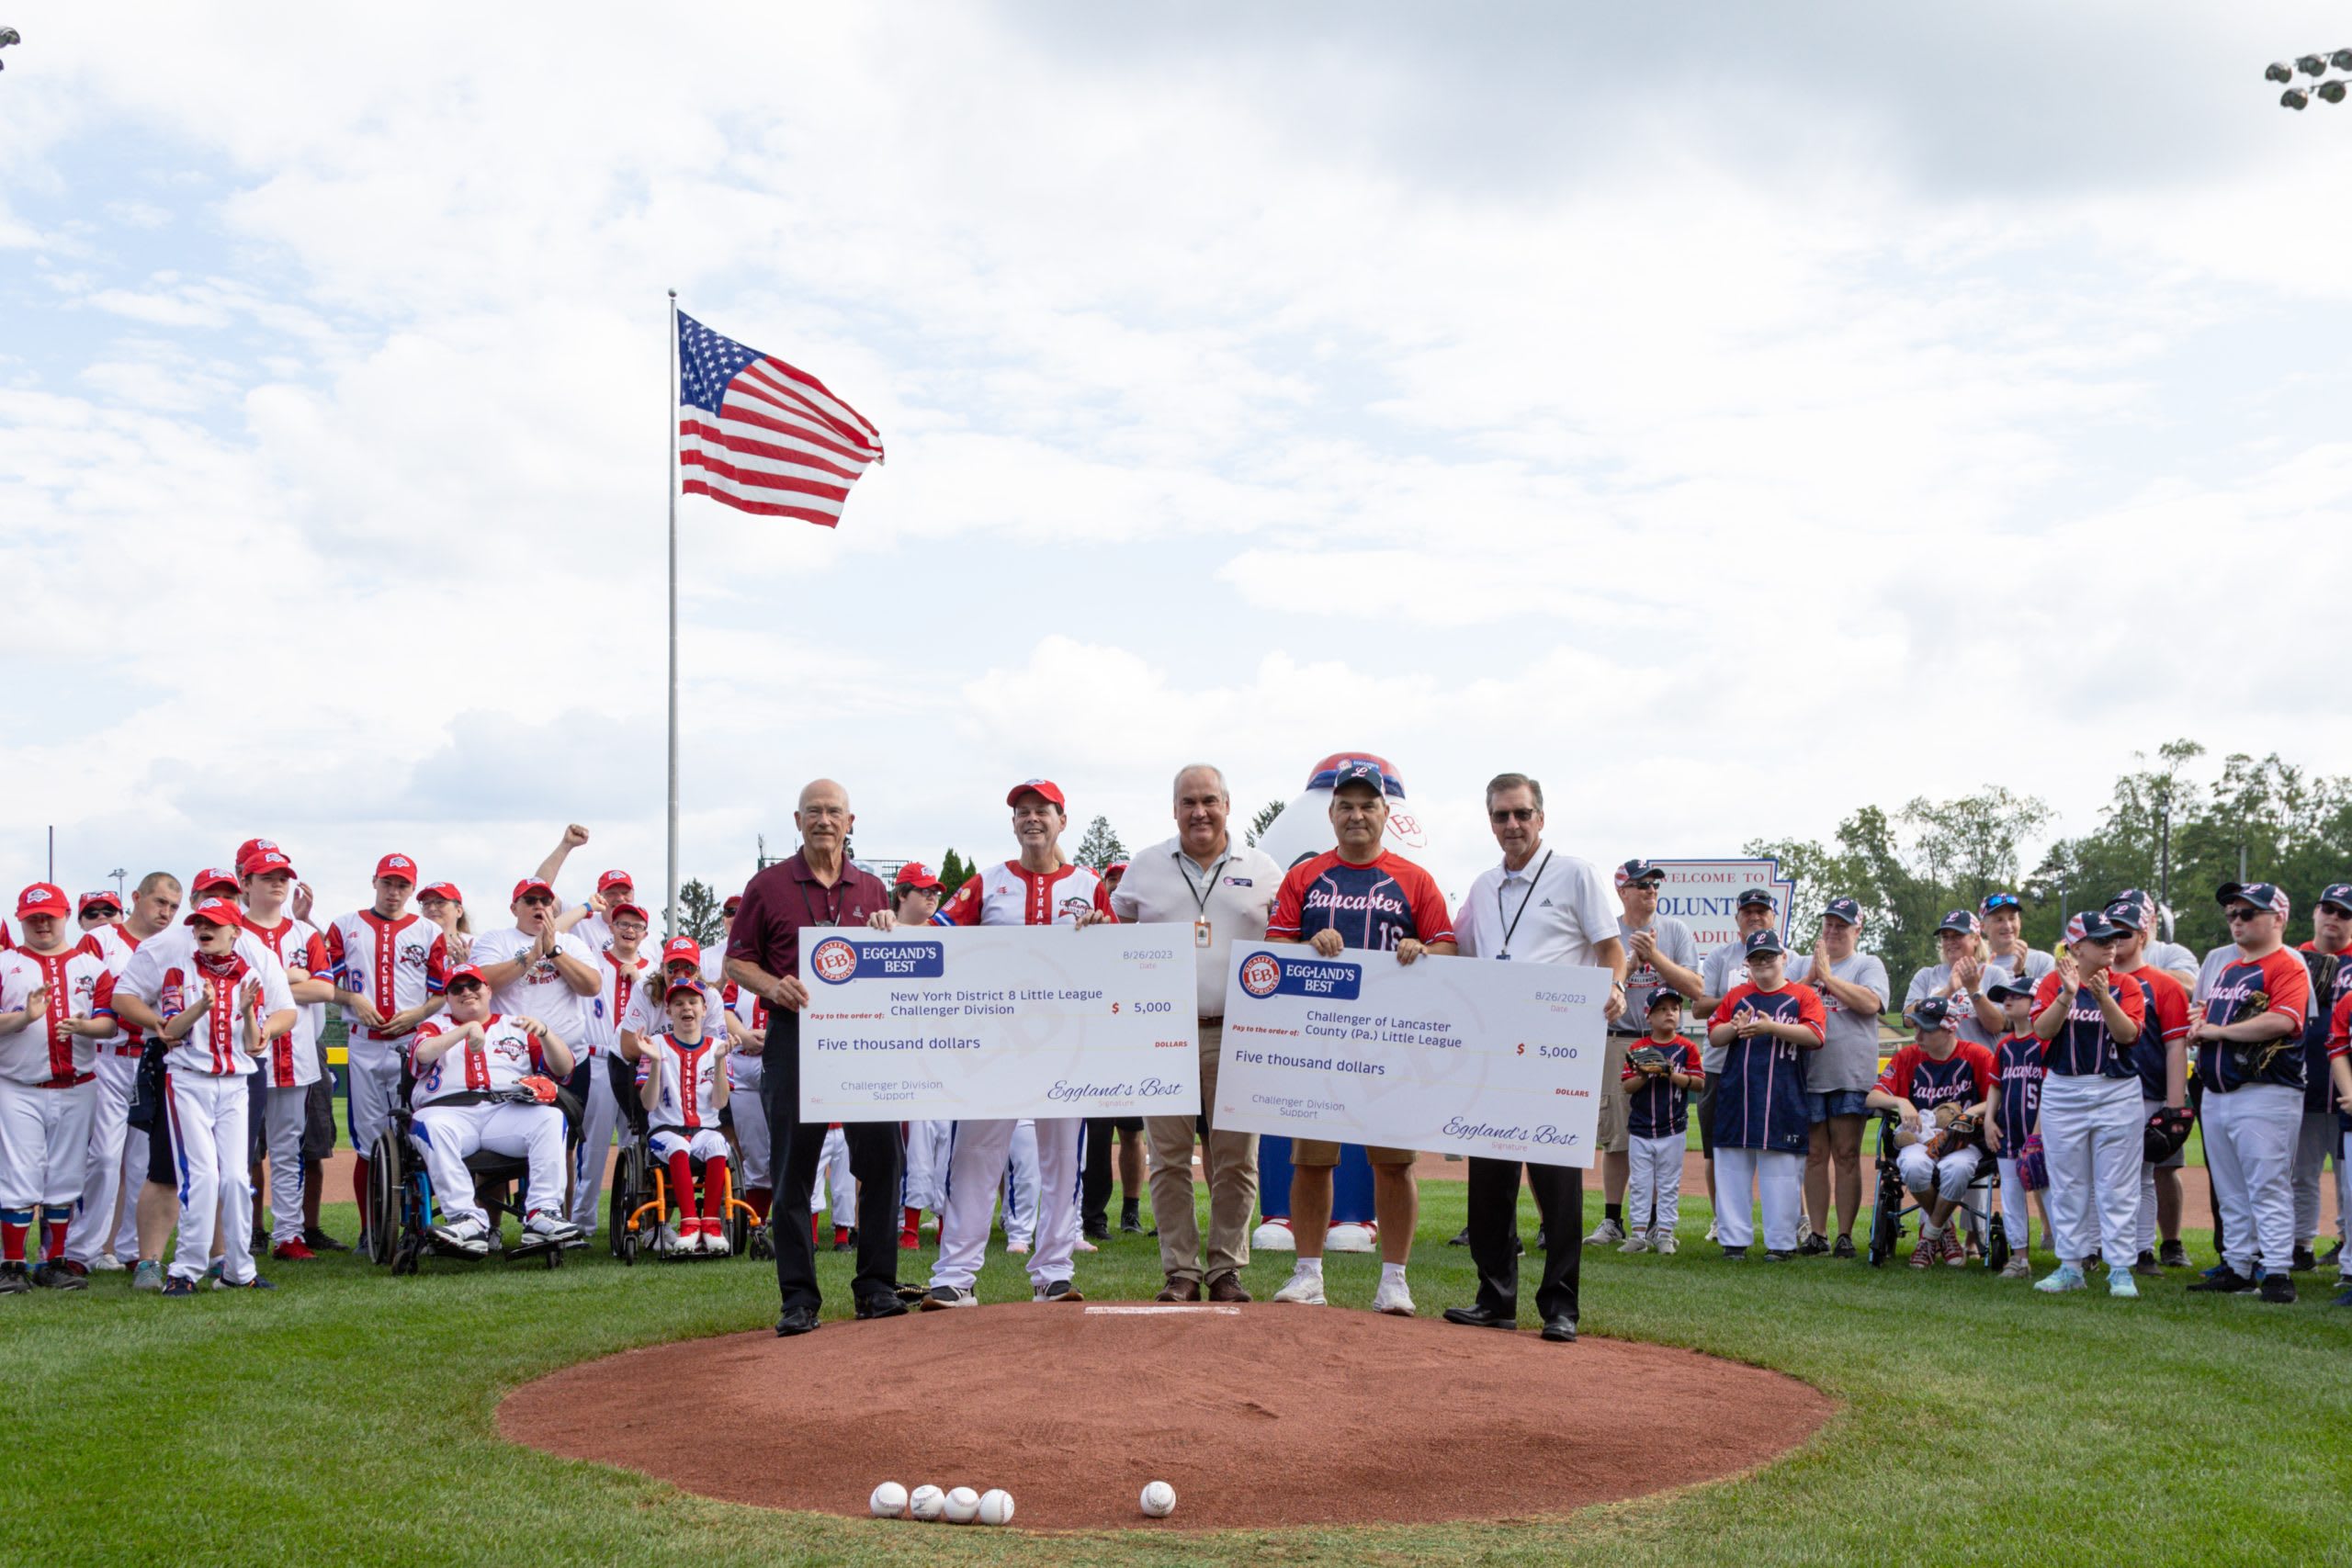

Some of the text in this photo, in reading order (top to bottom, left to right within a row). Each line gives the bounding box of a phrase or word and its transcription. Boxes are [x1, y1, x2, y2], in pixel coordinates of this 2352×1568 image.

[1744, 873, 1765, 883] TO
[1303, 888, 1404, 915] Lancaster
[817, 942, 848, 960] QUALITY
[1123, 950, 1173, 960] 8/26/2023
[381, 924, 390, 1006] SYRACUSE
[824, 953, 848, 969] EB
[885, 961, 916, 973] BEST
[1245, 956, 1274, 973] QUALITY
[820, 959, 855, 980] APPROVED
[1251, 968, 1272, 982] EB
[1247, 975, 1278, 994] APPROVED
[1305, 979, 1335, 993] BEST
[890, 989, 1102, 1002] New York District 8 Little League
[1535, 991, 1586, 1004] 8/26/2023
[890, 1004, 1014, 1017] Challenger Division
[1112, 1002, 1171, 1014] $ 5,000
[1232, 1024, 1245, 1032] Pay
[1306, 1010, 1452, 1032] Challenger of Lancaster
[1306, 1024, 1462, 1048] County (Pa.) Little League
[818, 1038, 980, 1050] Five thousand dollars
[1517, 1043, 1577, 1058] $ 5,000
[1236, 1050, 1385, 1075] Five thousand dollars
[841, 1080, 943, 1091] Challenger Division
[1047, 1077, 1182, 1102] Eggland's Best
[873, 1091, 914, 1100] Support
[1555, 1088, 1589, 1098] DOLLARS
[2026, 1083, 2038, 1111] 5
[1251, 1094, 1345, 1111] Challenger Division
[1280, 1107, 1317, 1119] Support
[1442, 1116, 1580, 1146] Eggland's Best
